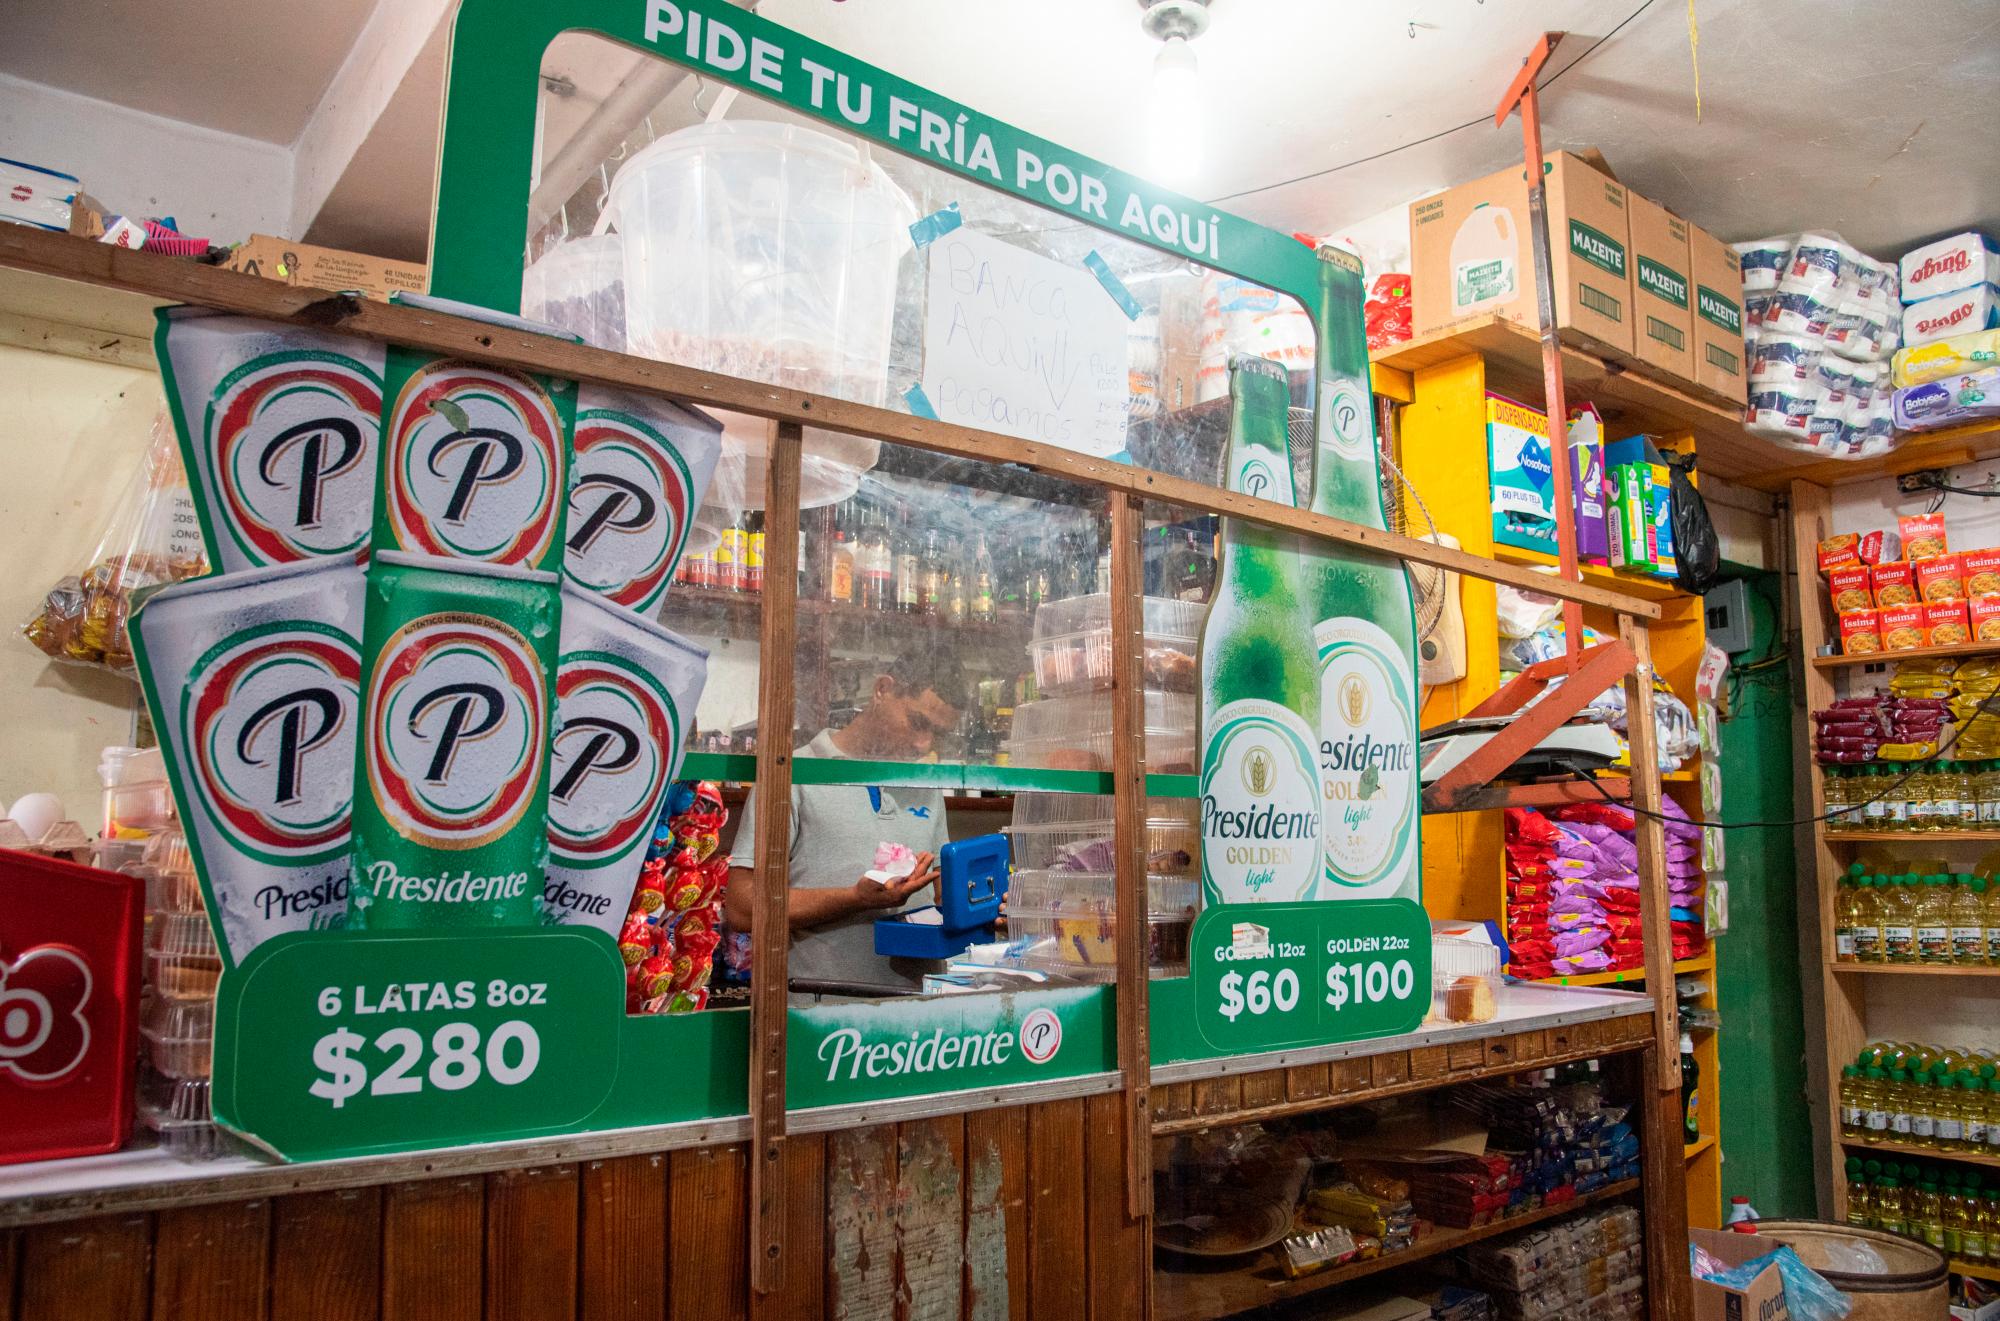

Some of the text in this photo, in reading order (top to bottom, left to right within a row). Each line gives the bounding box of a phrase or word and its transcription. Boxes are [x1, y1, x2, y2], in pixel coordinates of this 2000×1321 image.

[644, 0, 1220, 260] PIDE TU FRÍA POR AQUÍ
[1573, 229, 1622, 269] MAZEITE
[1910, 250, 1971, 283] Bingo
[1641, 264, 1685, 300] MAZEITE
[1700, 294, 1739, 327] MAZEITE
[1916, 302, 1975, 333] Bingo
[1338, 406, 1356, 432] P
[1905, 391, 1948, 411] Babysec
[259, 417, 365, 529] P
[427, 428, 526, 526] P
[1520, 453, 1551, 474] Nosotras
[1502, 489, 1541, 505] 60 PLUS TELA
[566, 474, 657, 559] P
[237, 687, 346, 808] P
[408, 683, 508, 786] P
[1320, 734, 1412, 772] esidente
[551, 717, 641, 805] P
[1202, 794, 1320, 840] Presidente
[1344, 804, 1374, 832] light
[1226, 847, 1292, 866] GOLDEN
[368, 861, 528, 903] Presidente
[1245, 868, 1276, 893] light
[1327, 937, 1380, 955] GOLDEN
[317, 987, 343, 1016] 6
[354, 981, 477, 1015] LATAS
[1218, 968, 1300, 1023] $60
[1325, 959, 1414, 1012] $100
[816, 1027, 1014, 1082] Presidente
[1030, 1022, 1050, 1050] P
[308, 1020, 541, 1109] $280
